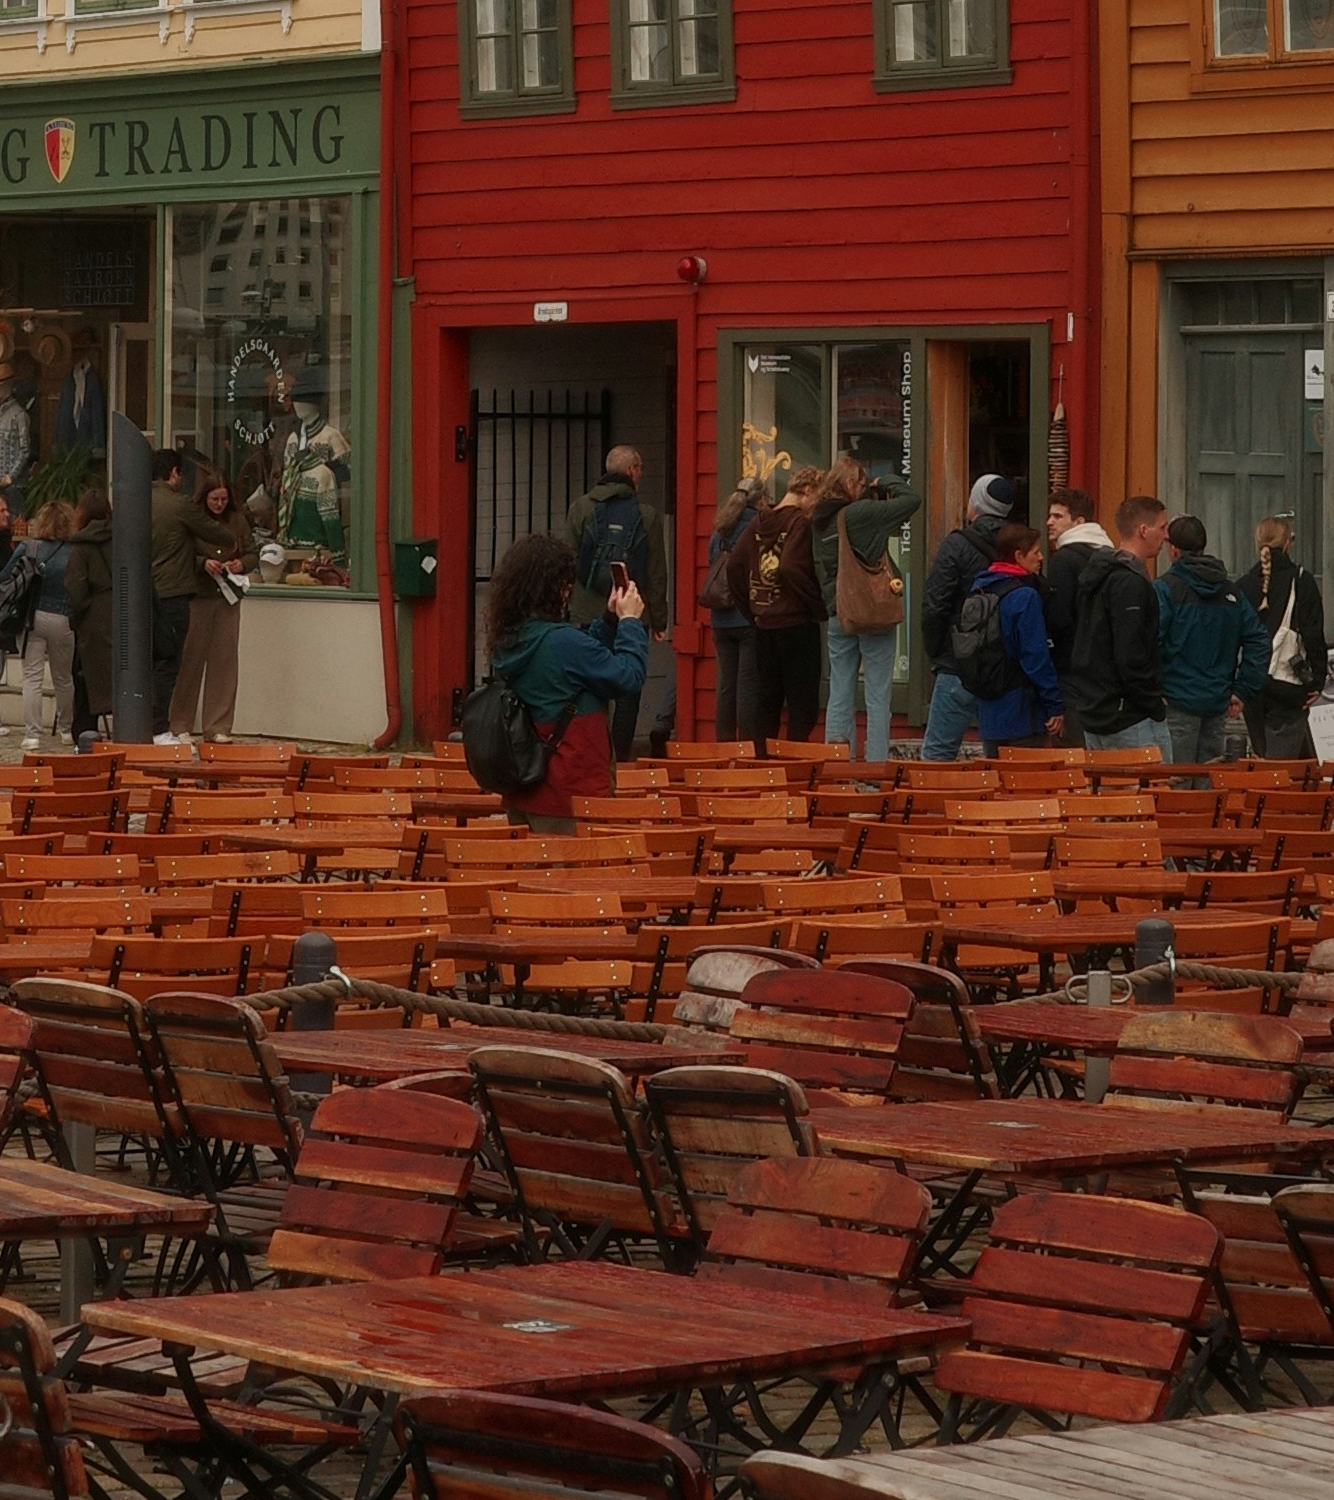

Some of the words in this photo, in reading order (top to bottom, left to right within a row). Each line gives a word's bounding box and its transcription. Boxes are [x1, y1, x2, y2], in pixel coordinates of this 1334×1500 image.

[89, 104, 345, 179] TRADING
[227, 338, 285, 404] HANDELSGAARDEN
[901, 351, 911, 396] Shop
[234, 419, 276, 446] SCHJØTT
[901, 400, 911, 475] Museum
[900, 520, 911, 554] Tick
